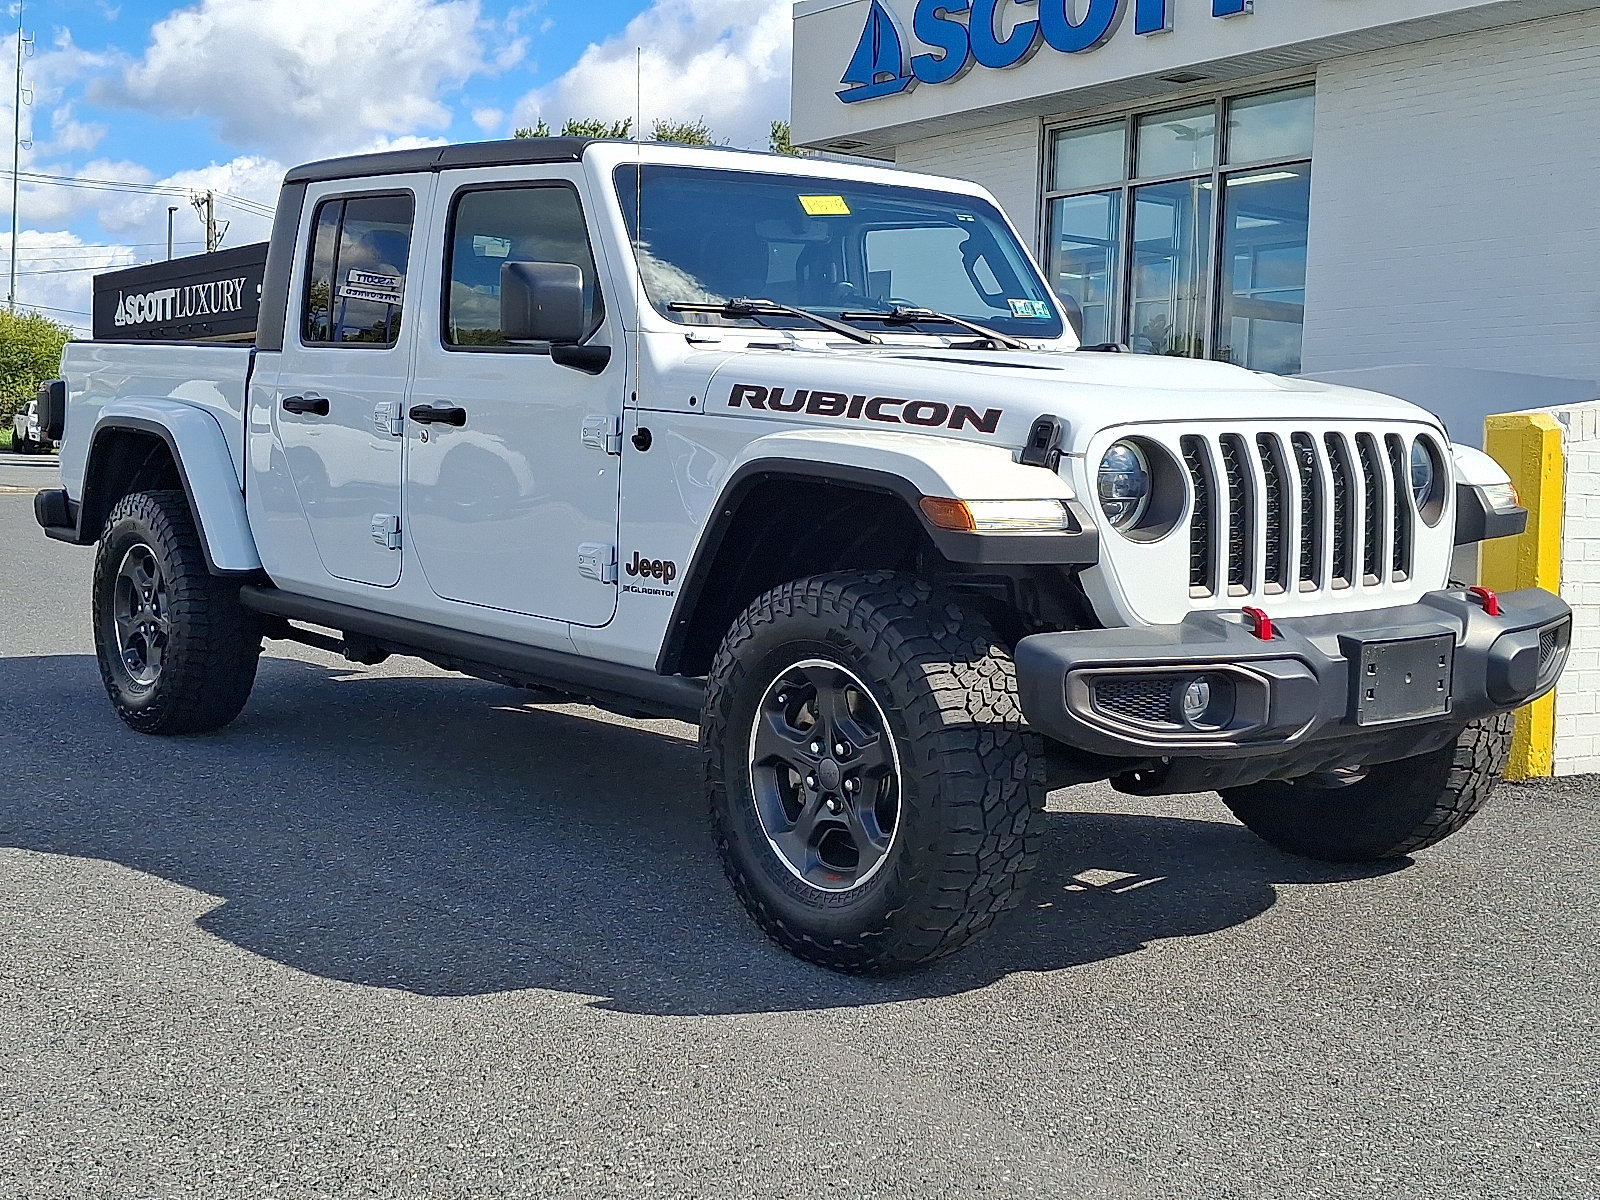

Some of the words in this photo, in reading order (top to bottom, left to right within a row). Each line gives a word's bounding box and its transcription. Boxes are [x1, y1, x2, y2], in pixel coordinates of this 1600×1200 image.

[728, 383, 1004, 434] RUBICON
[625, 551, 677, 585] Jeep
[631, 586, 675, 597] GLADIATOR
